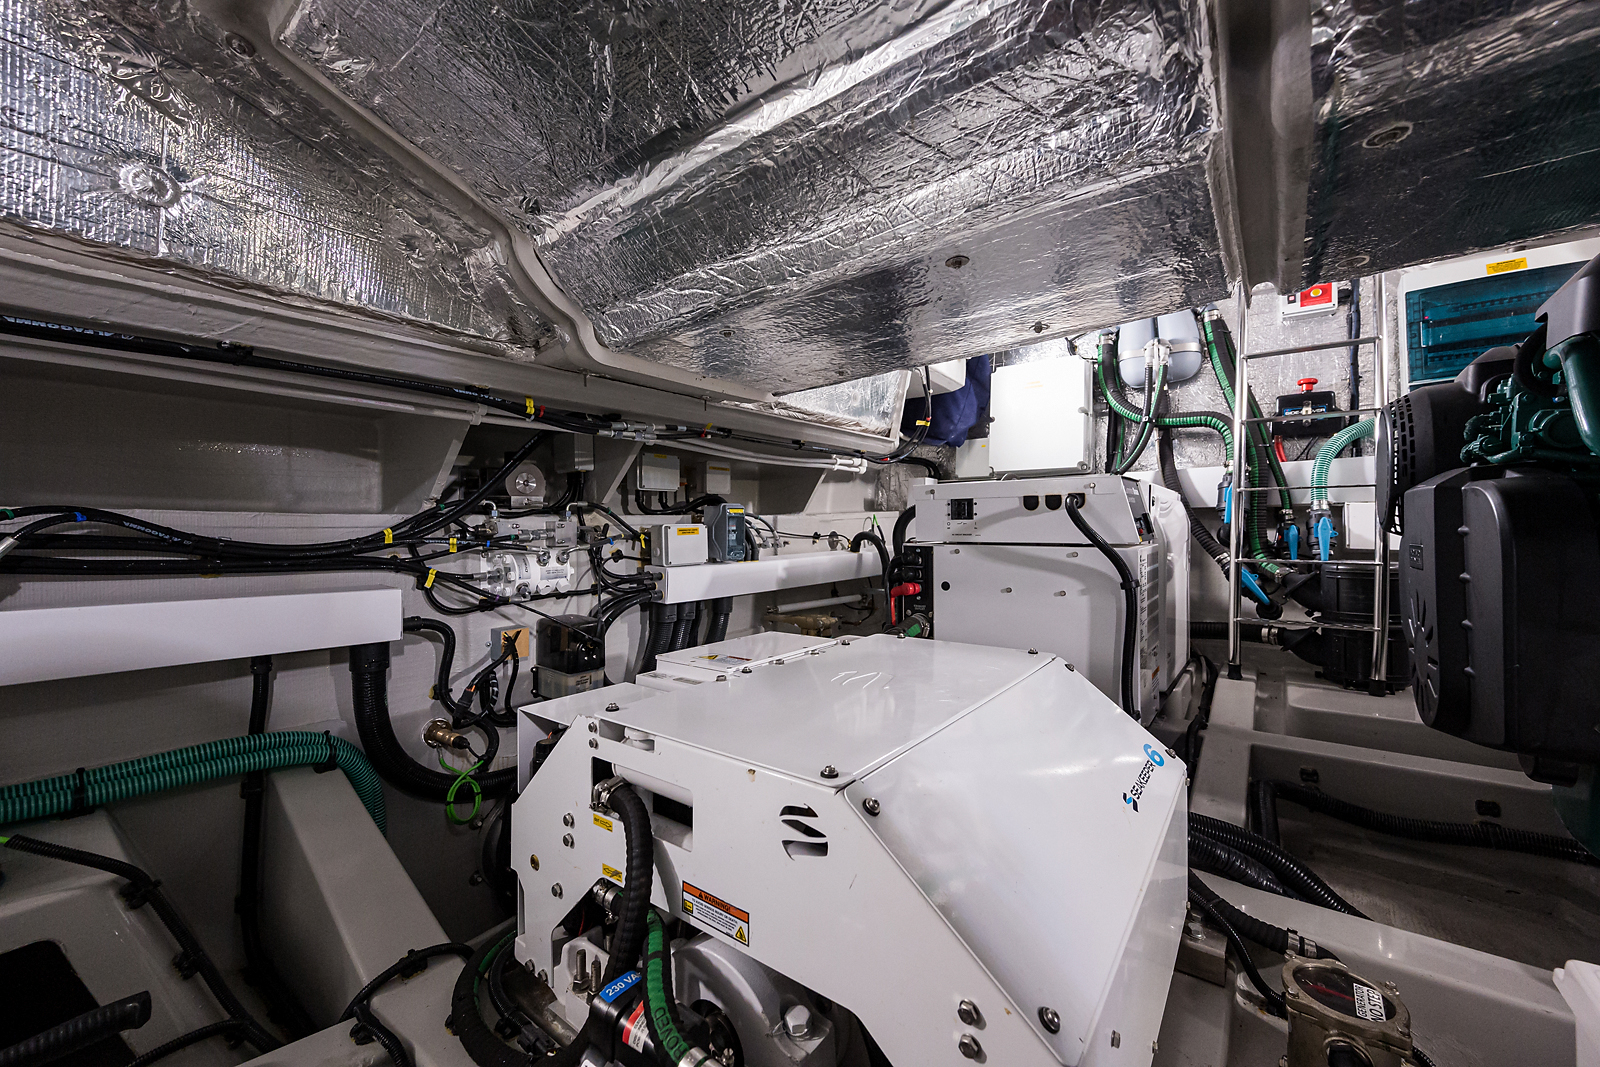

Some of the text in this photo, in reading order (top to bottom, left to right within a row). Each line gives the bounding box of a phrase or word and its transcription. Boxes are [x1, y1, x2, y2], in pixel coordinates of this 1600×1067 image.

[2, 315, 116, 338] ALFAGOMMA
[1130, 743, 1165, 800] SEAKEEPER 6
[605, 981, 625, 997] 230
[1355, 984, 1368, 1018] GENERATOR
[1366, 988, 1385, 1022] NO STEP
